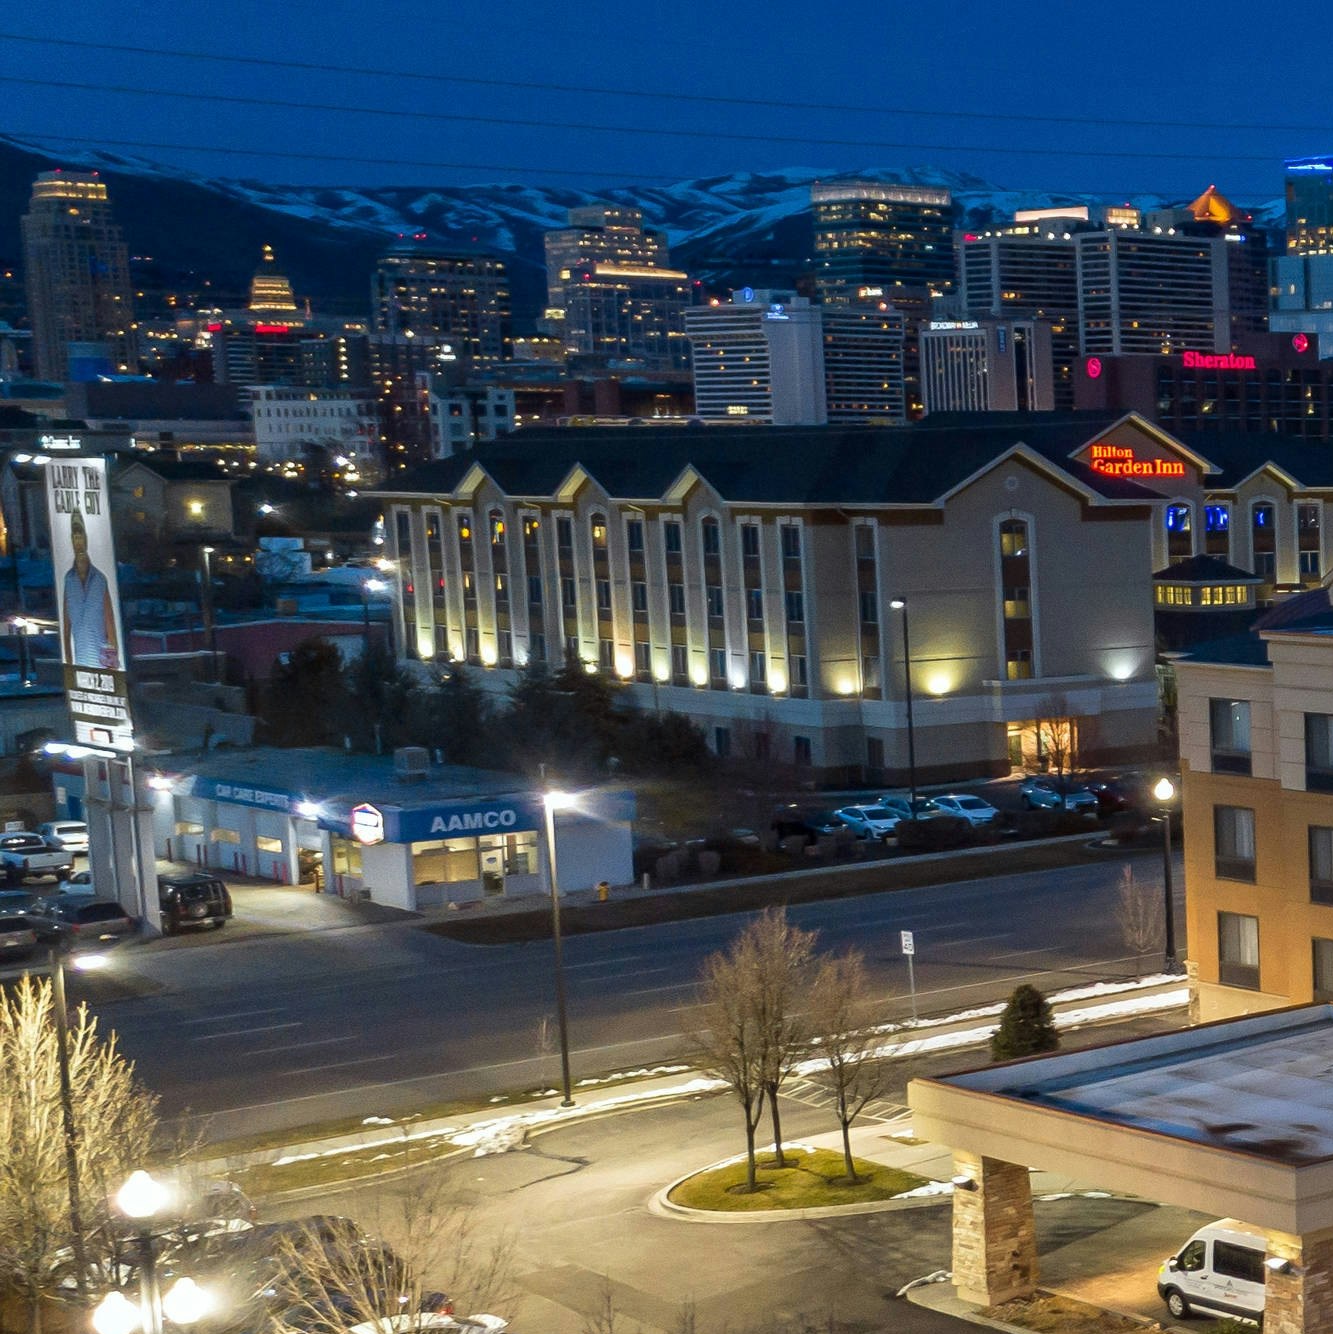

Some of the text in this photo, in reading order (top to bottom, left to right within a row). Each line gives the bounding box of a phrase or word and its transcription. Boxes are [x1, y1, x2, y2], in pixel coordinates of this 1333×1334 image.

[1183, 351, 1255, 369] Sheraton
[1092, 445, 1133, 459] Hilton
[1093, 459, 1184, 476] Garden Inn
[430, 810, 517, 833] AAMCO
